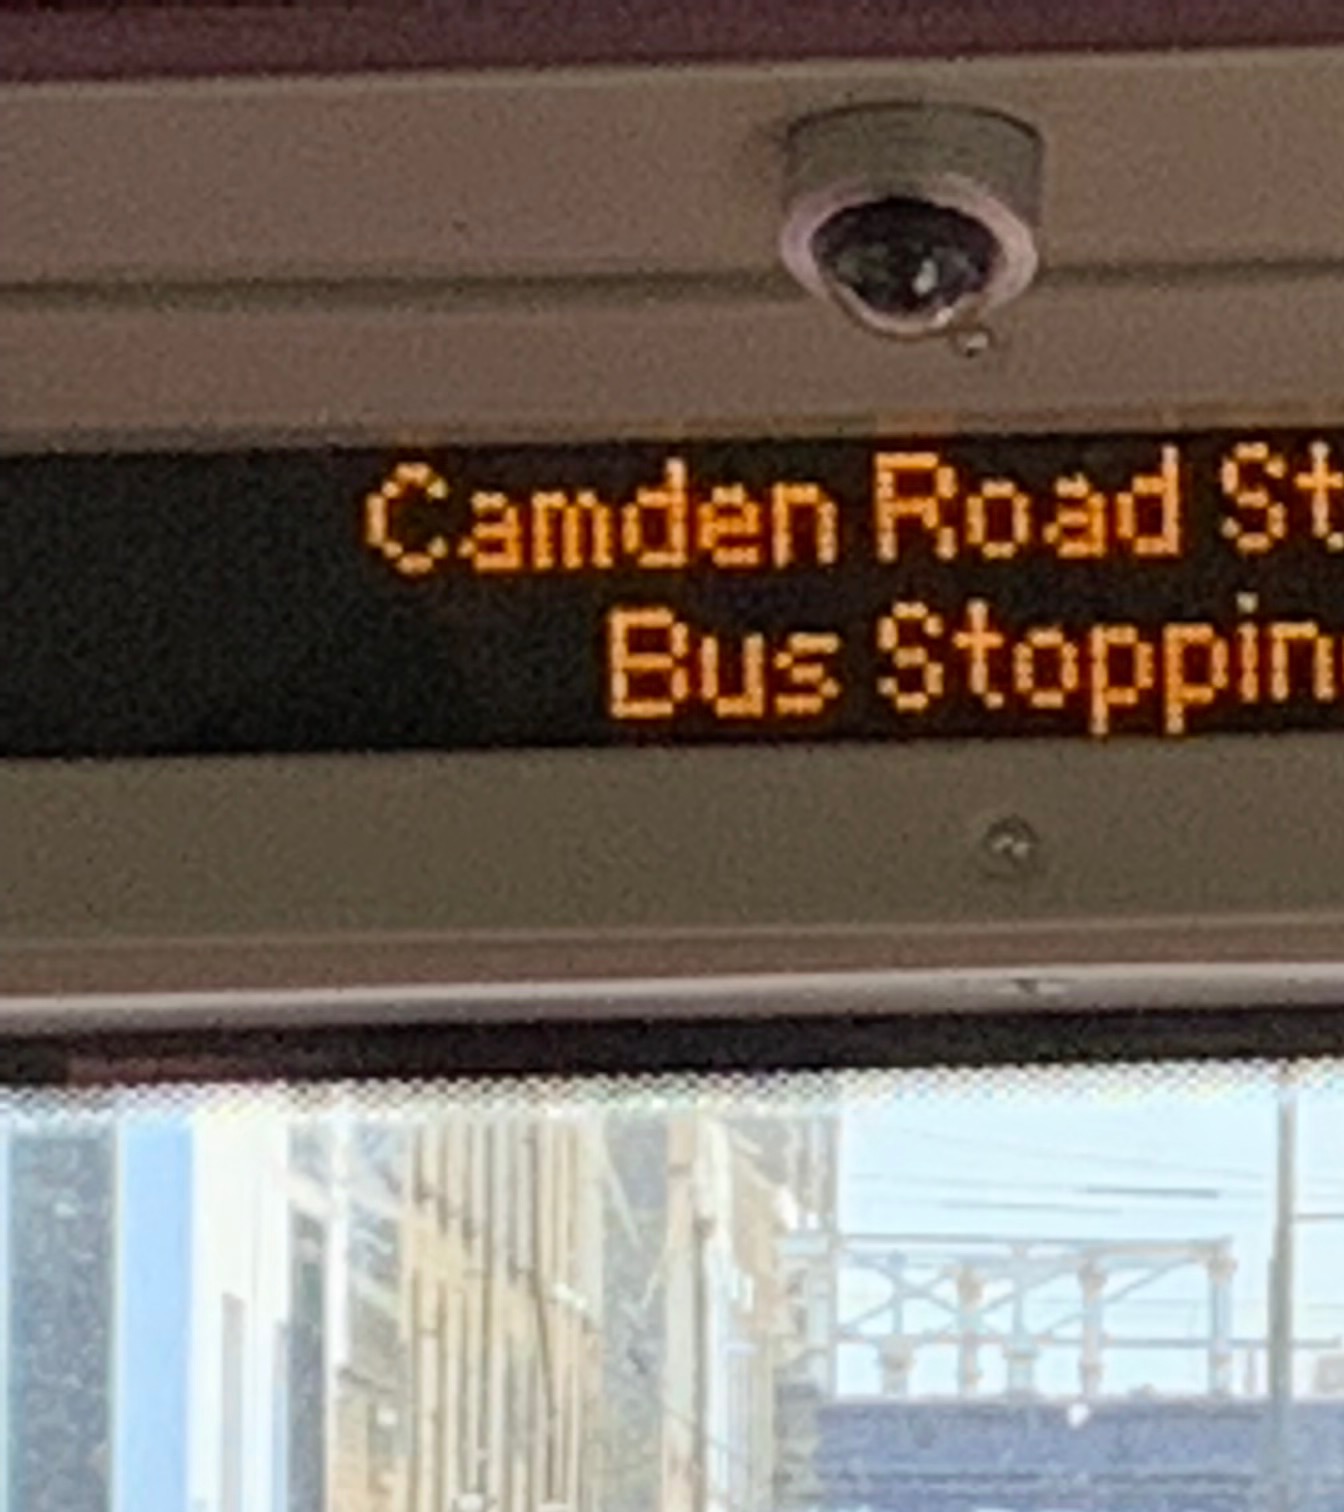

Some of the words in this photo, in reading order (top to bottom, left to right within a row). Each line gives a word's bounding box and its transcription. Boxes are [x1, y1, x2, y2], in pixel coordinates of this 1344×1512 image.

[366, 462, 838, 574] Camden
[875, 451, 1181, 560] Road
[608, 607, 840, 719] Bus
